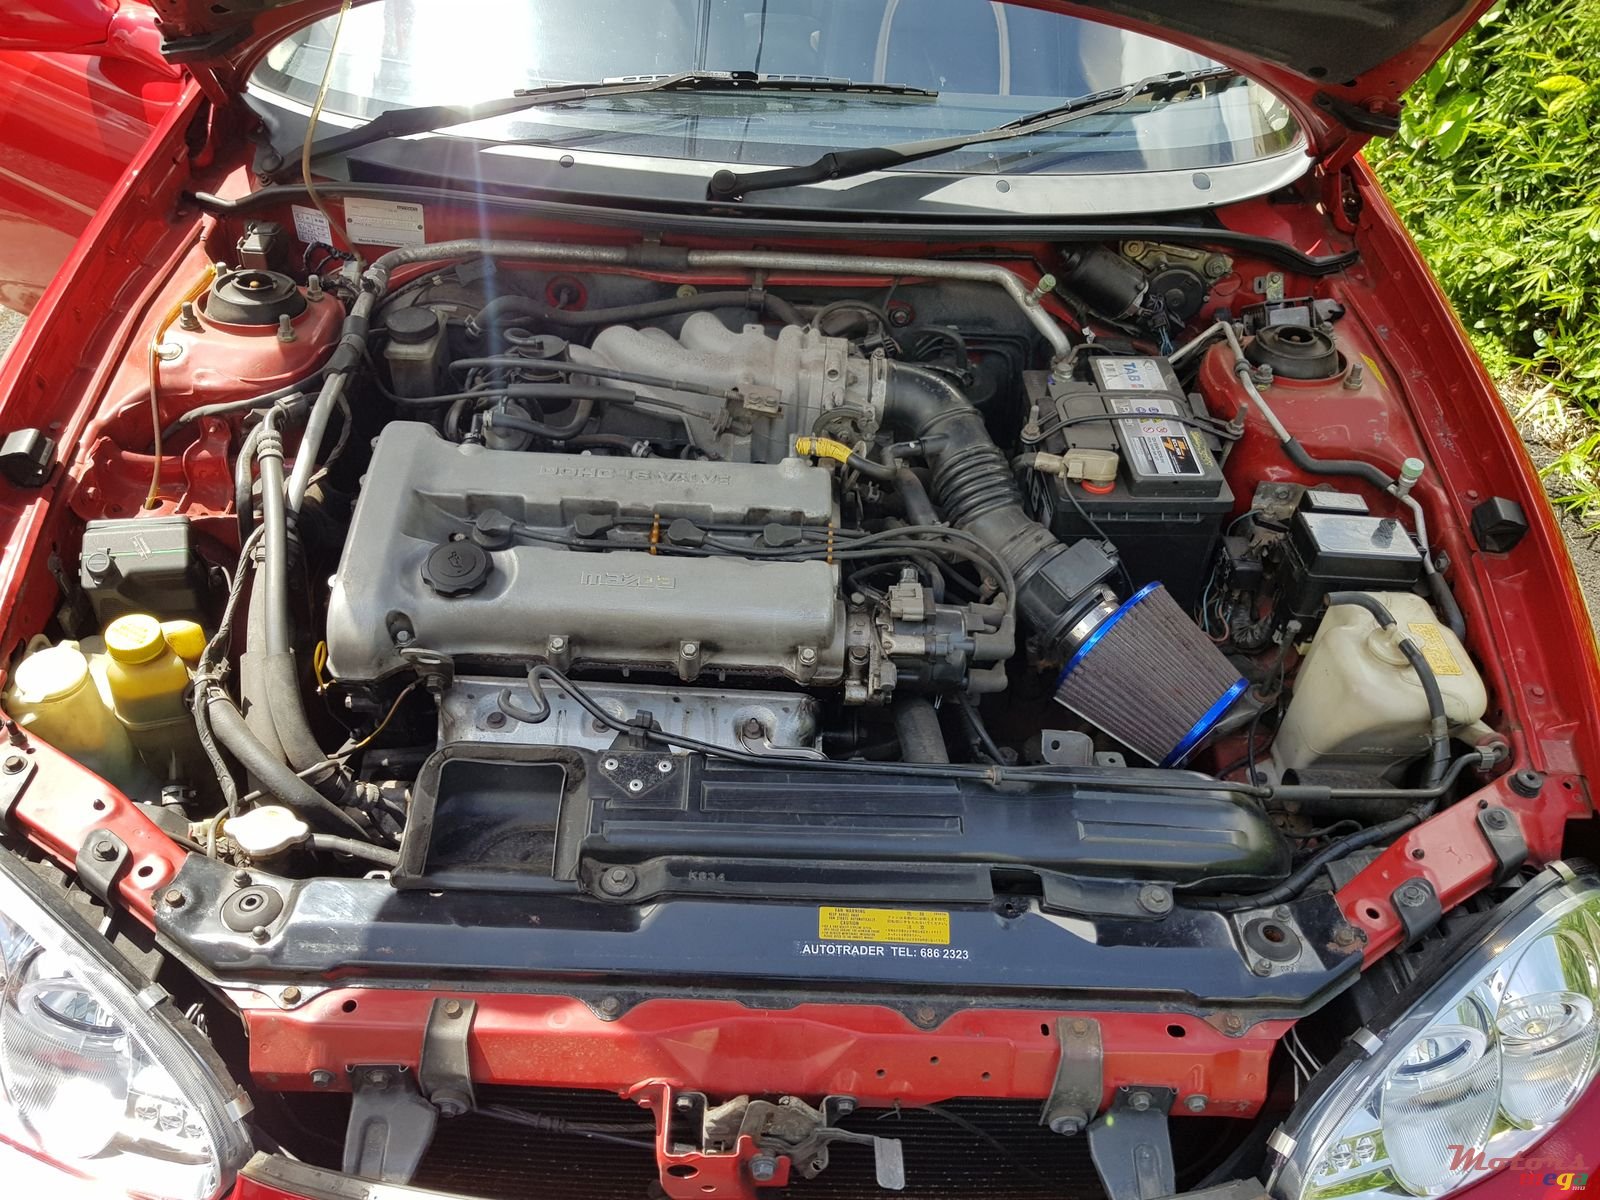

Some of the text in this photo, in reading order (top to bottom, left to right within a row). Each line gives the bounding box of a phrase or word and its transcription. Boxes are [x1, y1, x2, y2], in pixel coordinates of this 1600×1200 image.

[1122, 361, 1142, 382] TAB
[802, 944, 969, 960] AUTOTRADER TEL: 686 2323
